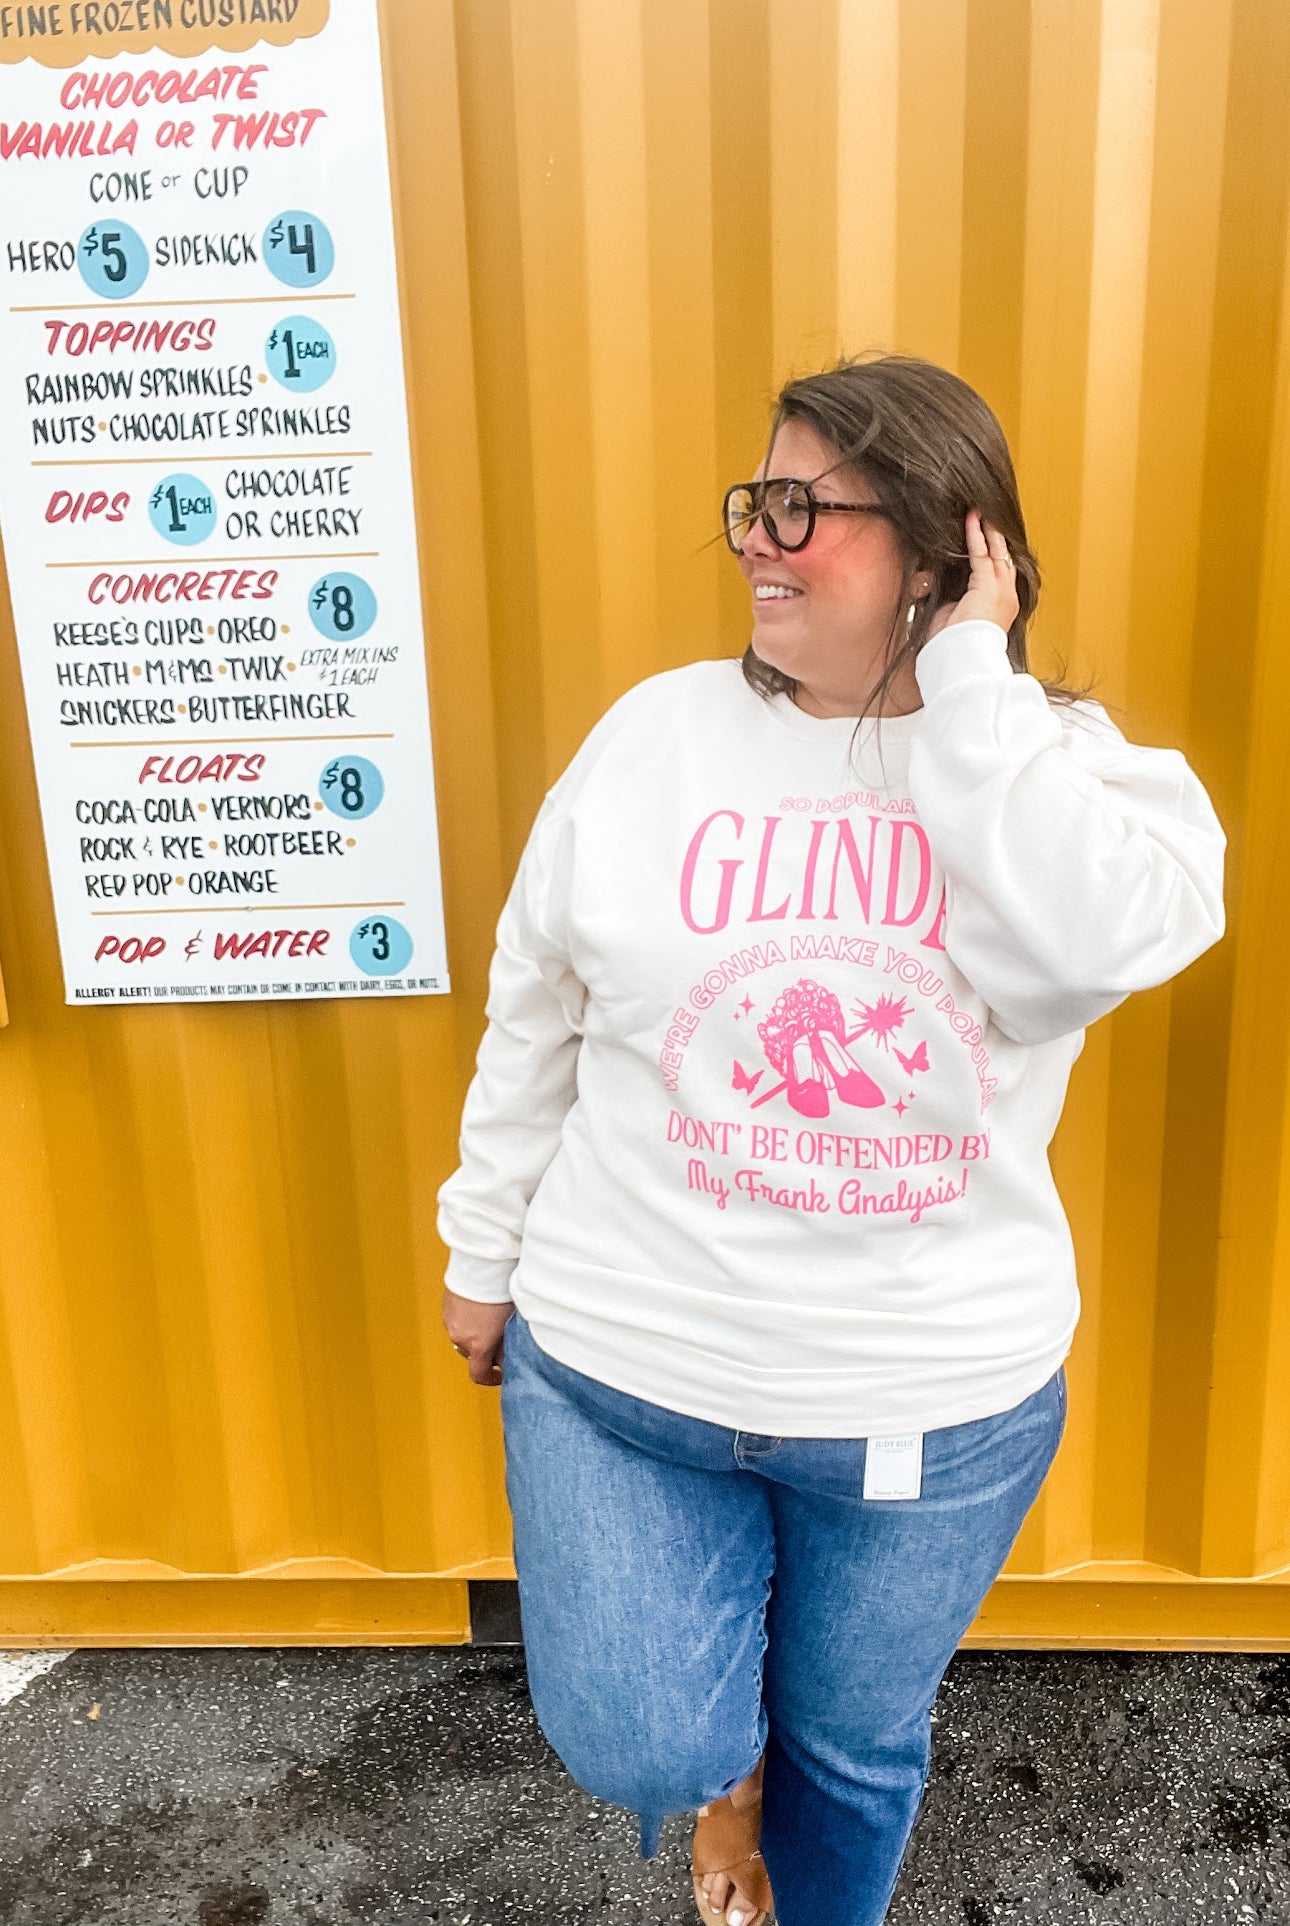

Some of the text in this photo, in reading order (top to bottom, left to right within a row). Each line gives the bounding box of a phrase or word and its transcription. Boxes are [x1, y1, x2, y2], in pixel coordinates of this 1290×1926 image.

[1, 0, 299, 38] FINE FROZEN CUSTARD
[60, 64, 269, 110] CHOCOLATE
[0, 109, 328, 160] VANILLA OR TWIST
[89, 166, 249, 203] CONE or CUP
[7, 220, 317, 282] HERO $5 SIDEKICK $4
[44, 318, 217, 356] TOPPINGS
[267, 330, 329, 378] $1 EACH
[25, 365, 253, 405] RAINBOW SPRINKLES
[32, 405, 352, 446] NUTS CHOCOLATE SPRINKLES
[225, 466, 354, 499] CHOCOLATE
[44, 490, 131, 524] DIPS
[150, 485, 212, 531] $1 EACH
[226, 507, 364, 540] OR CHERRY
[87, 570, 279, 605] CONCRETES
[312, 580, 355, 632] $8
[145, 617, 204, 646] CUPS
[218, 616, 276, 643] OREO
[56, 661, 129, 686] HEATH
[225, 656, 287, 681] TWIX
[301, 647, 338, 666] EXTRA
[341, 667, 379, 685] EACH
[60, 693, 356, 725] SNICKERS BUTTERFINGER
[138, 754, 266, 784] FLOATS
[321, 762, 364, 812] $8
[75, 794, 312, 825] COCA-COLA VERNORS
[779, 791, 917, 814] SO POPULAR
[80, 837, 136, 863] ROCK
[143, 837, 154, 857] &
[161, 836, 204, 859] RYE
[85, 869, 279, 898] RED POP ORANGE
[94, 929, 331, 964] POP & WATER
[358, 922, 390, 961] $3
[75, 988, 115, 998] ALLERGY
[119, 987, 151, 997] ALERT!
[154, 987, 168, 996] OUR
[171, 986, 208, 996] PRODUCTS
[210, 985, 225, 995] MAY
[228, 985, 258, 995] CONTAIN
[261, 984, 269, 993] OR
[272, 983, 292, 993] COME
[296, 983, 302, 992] IN
[305, 982, 336, 992] CONTACT
[339, 981, 358, 991] WITH
[361, 980, 383, 991] DAIRY,
[385, 979, 406, 991] EGGS,
[408, 979, 416, 988] OR
[659, 1007, 701, 1092] WE'RE
[689, 940, 786, 1010] GONNA
[790, 935, 879, 968] MAKE
[884, 946, 943, 996] YOU
[666, 1110, 992, 1170] DONT' BE OFFENDED BY
[688, 1159, 968, 1223] My Frank Analysis!
